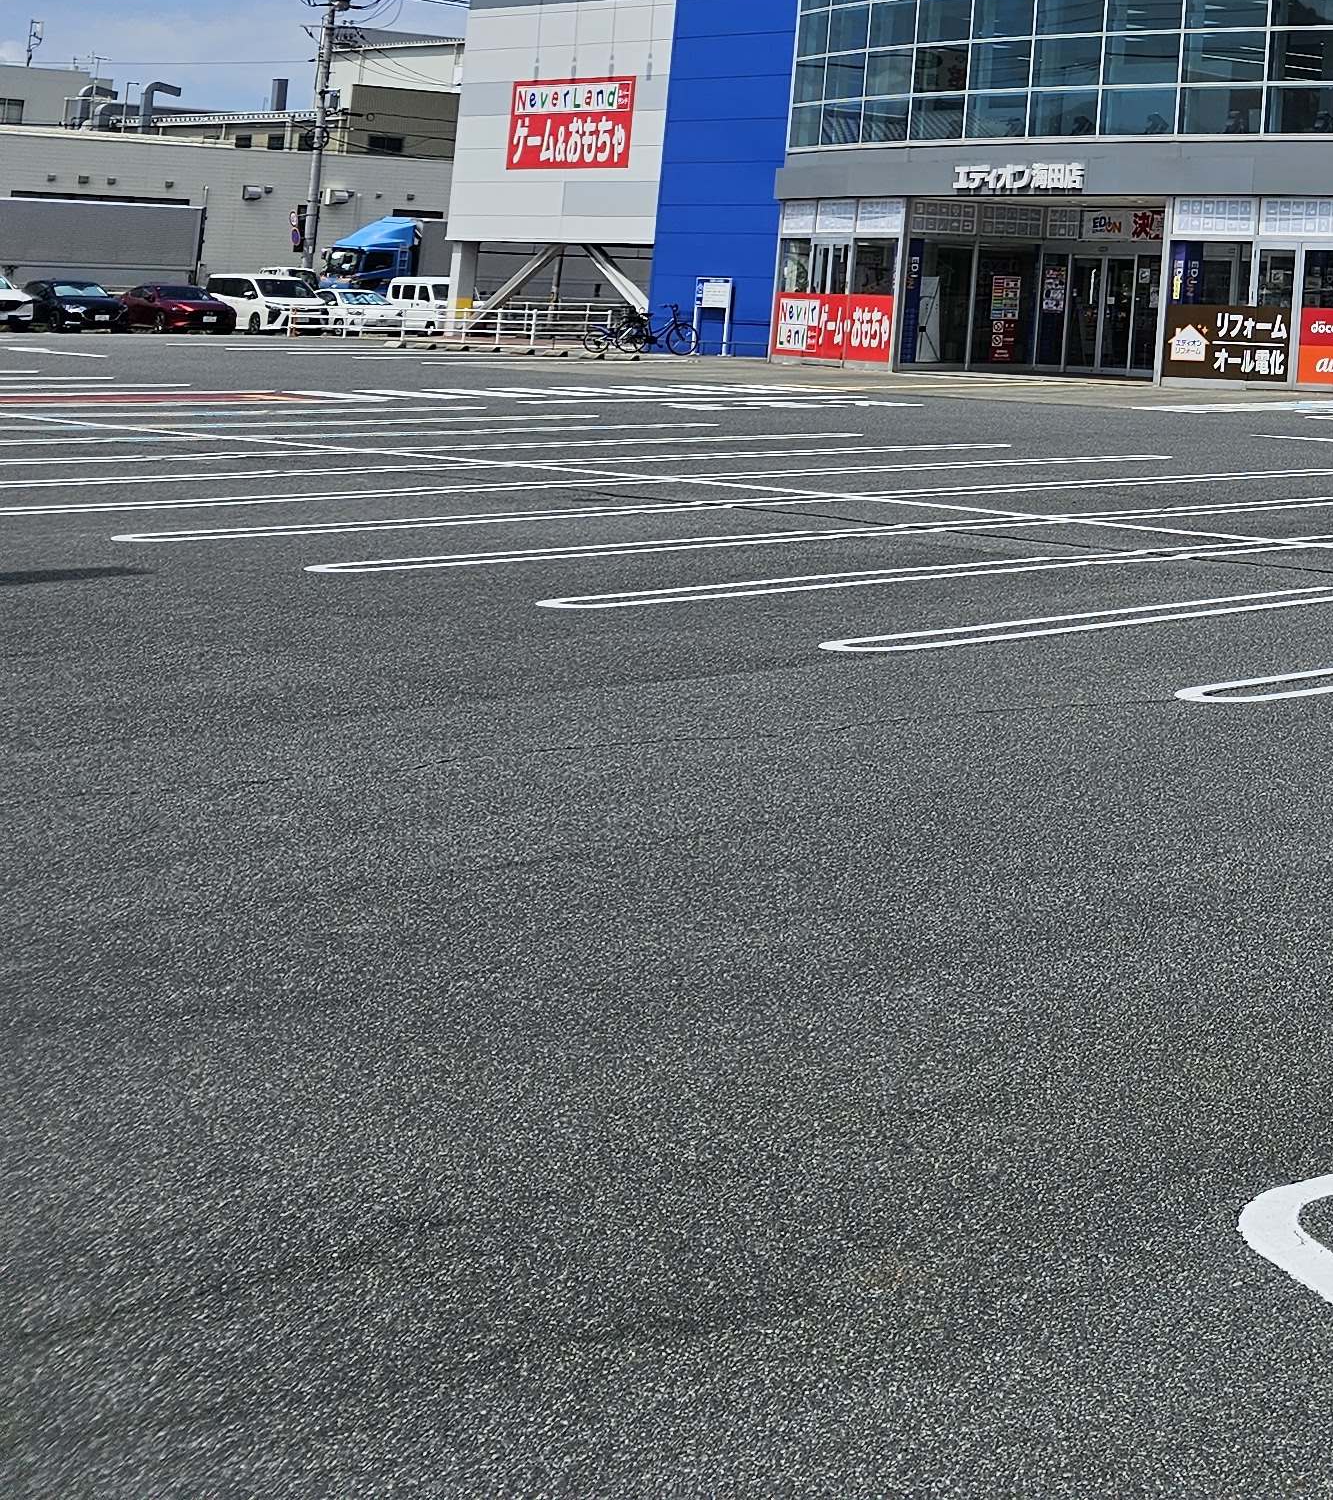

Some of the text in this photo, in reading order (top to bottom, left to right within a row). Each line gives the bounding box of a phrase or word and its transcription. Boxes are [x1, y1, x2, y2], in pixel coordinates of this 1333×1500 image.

[512, 115, 626, 164] ゲーム&おもちゃ
[1216, 312, 1288, 340] リフォーム
[1213, 348, 1285, 376] オール電化
